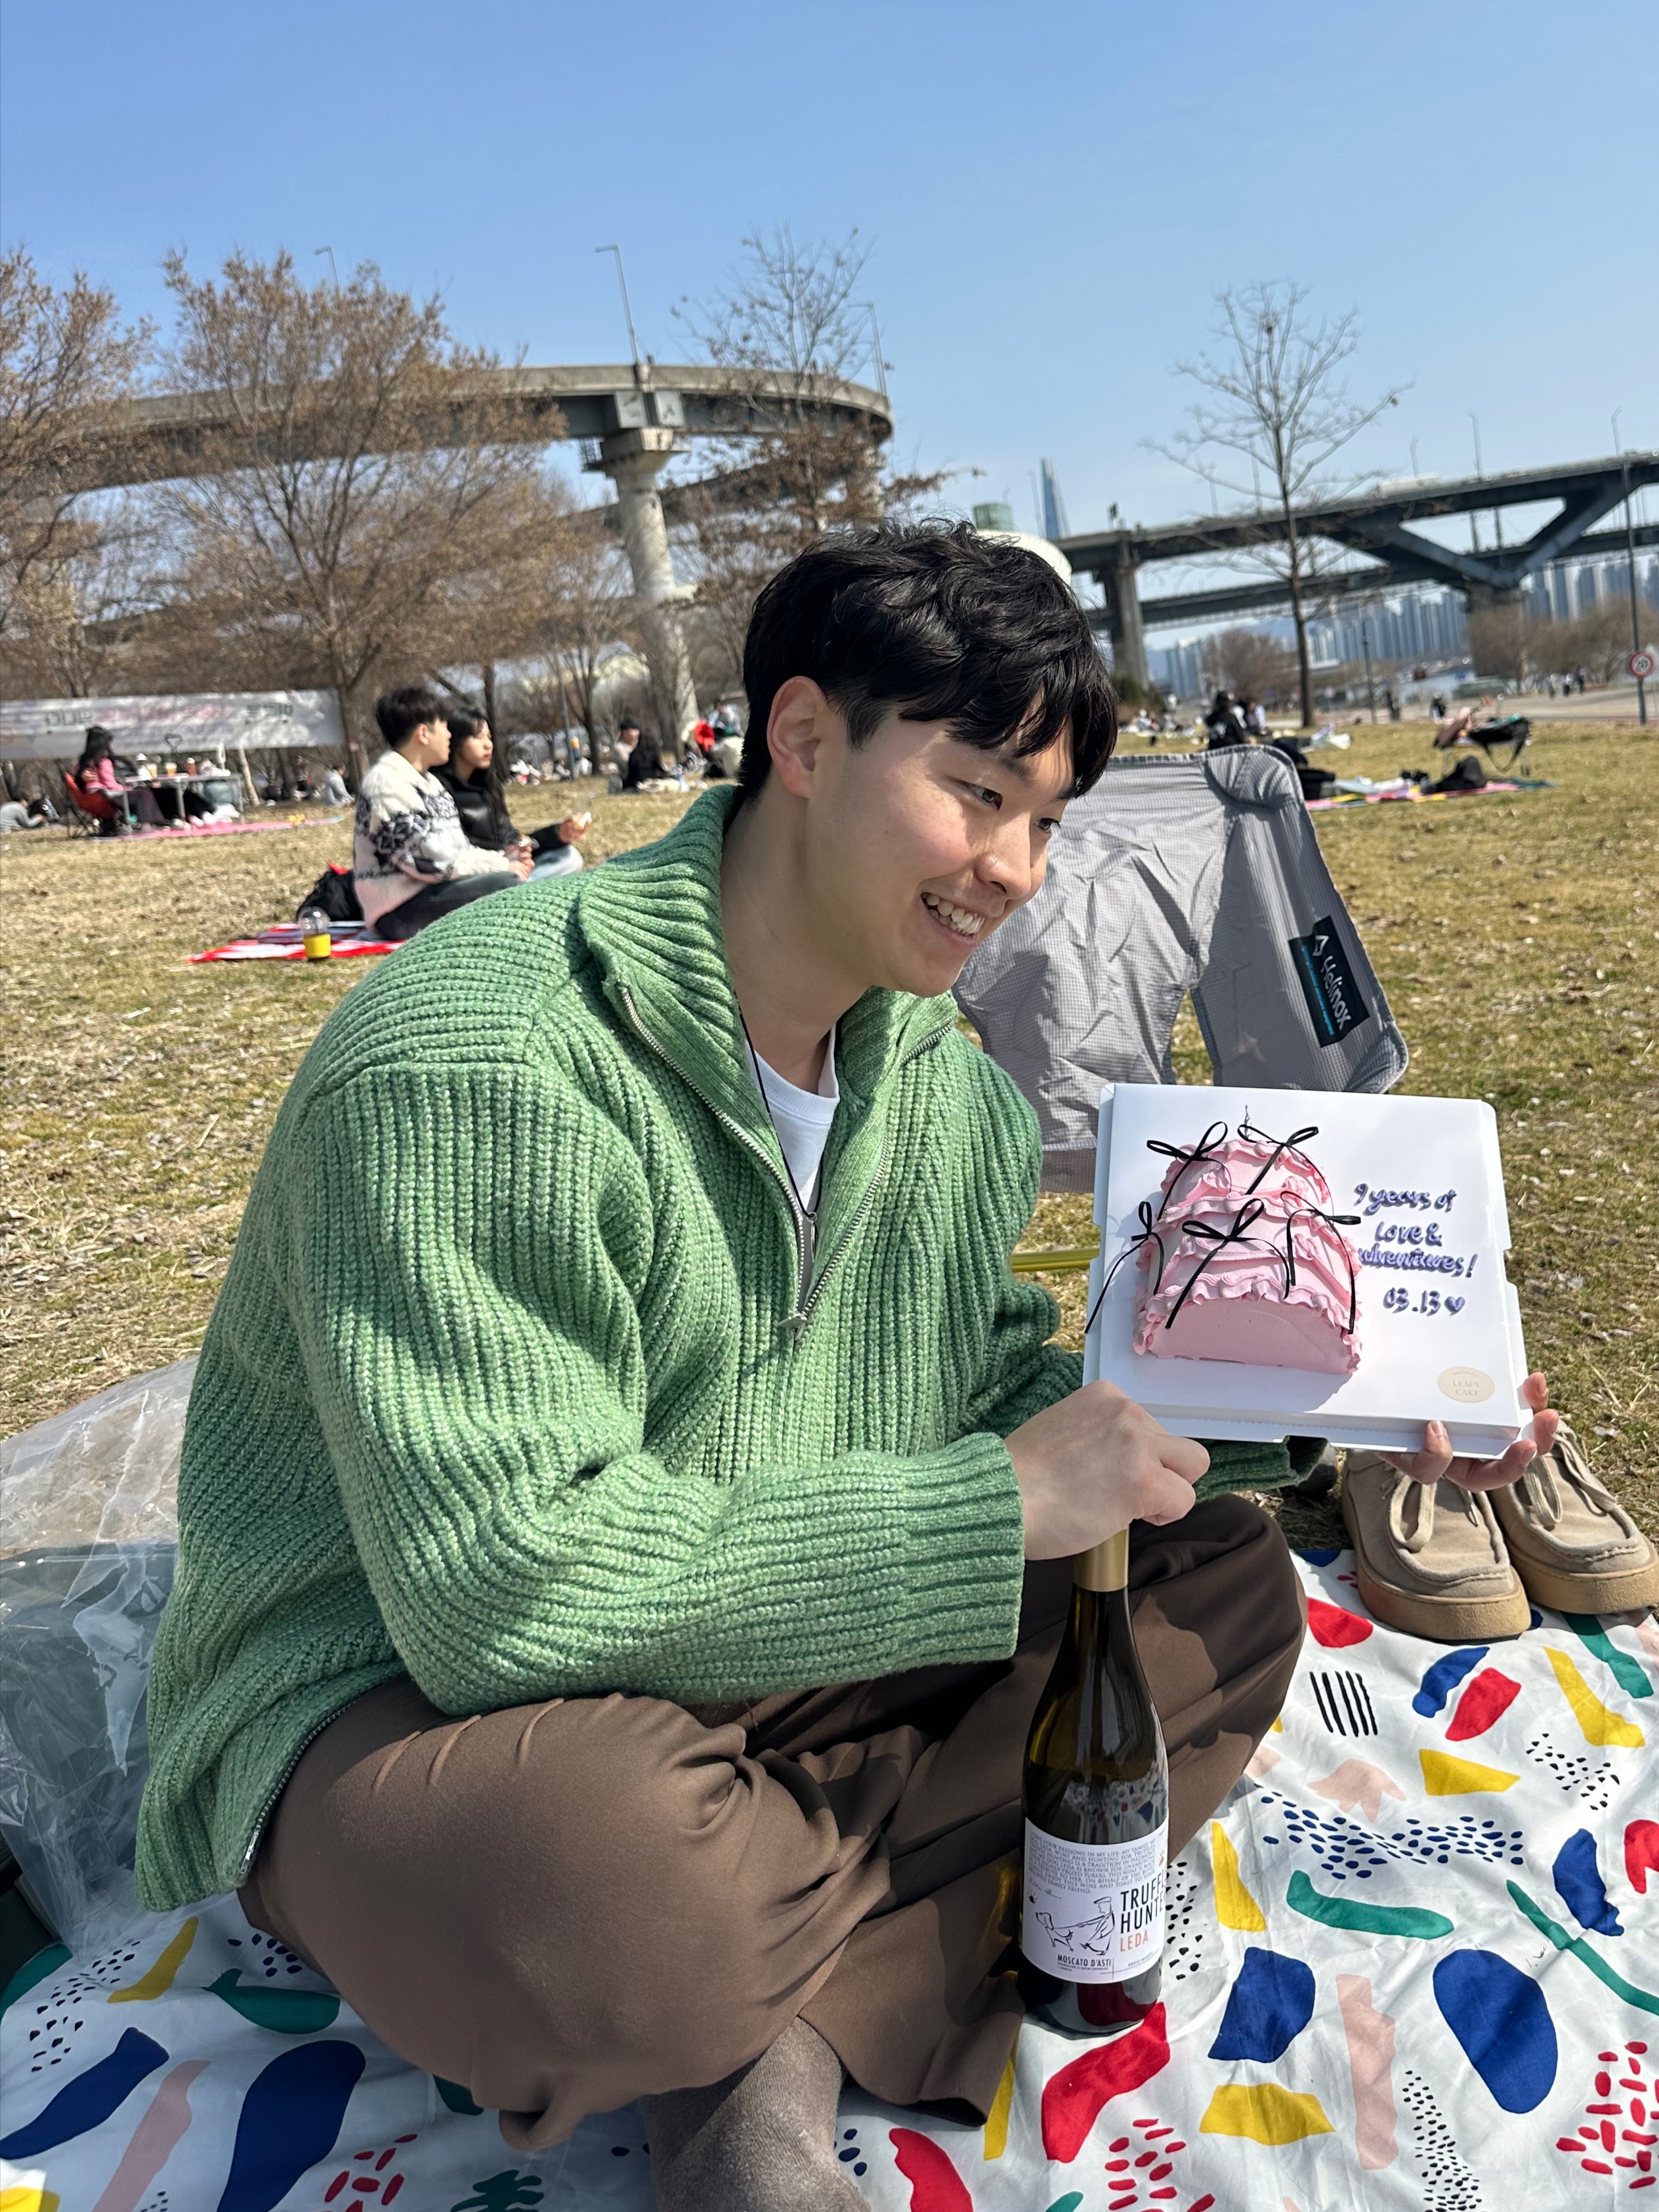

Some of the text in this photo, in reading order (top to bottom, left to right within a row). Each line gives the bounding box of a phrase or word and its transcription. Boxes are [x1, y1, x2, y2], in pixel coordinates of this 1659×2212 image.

[1321, 955, 1351, 1030] Helinox
[1354, 1183, 1457, 1216] 9 years of
[1055, 1850, 1070, 1859] WINE
[1059, 1845, 1085, 1856] PASSIONS
[1047, 1851, 1074, 1864] HUNTING
[1047, 1857, 1059, 1866] DOG
[1045, 1872, 1061, 1883] ENJOY
[1062, 1868, 1082, 1877] PRIZED
[1048, 1879, 1066, 1889] FAMILY
[1120, 1887, 1166, 1934] HUNTE
[1120, 1929, 1148, 1952] LEDA
[1057, 1953, 1088, 1967] MOSCATO
[1091, 1959, 1111, 1967] D'ASTI
